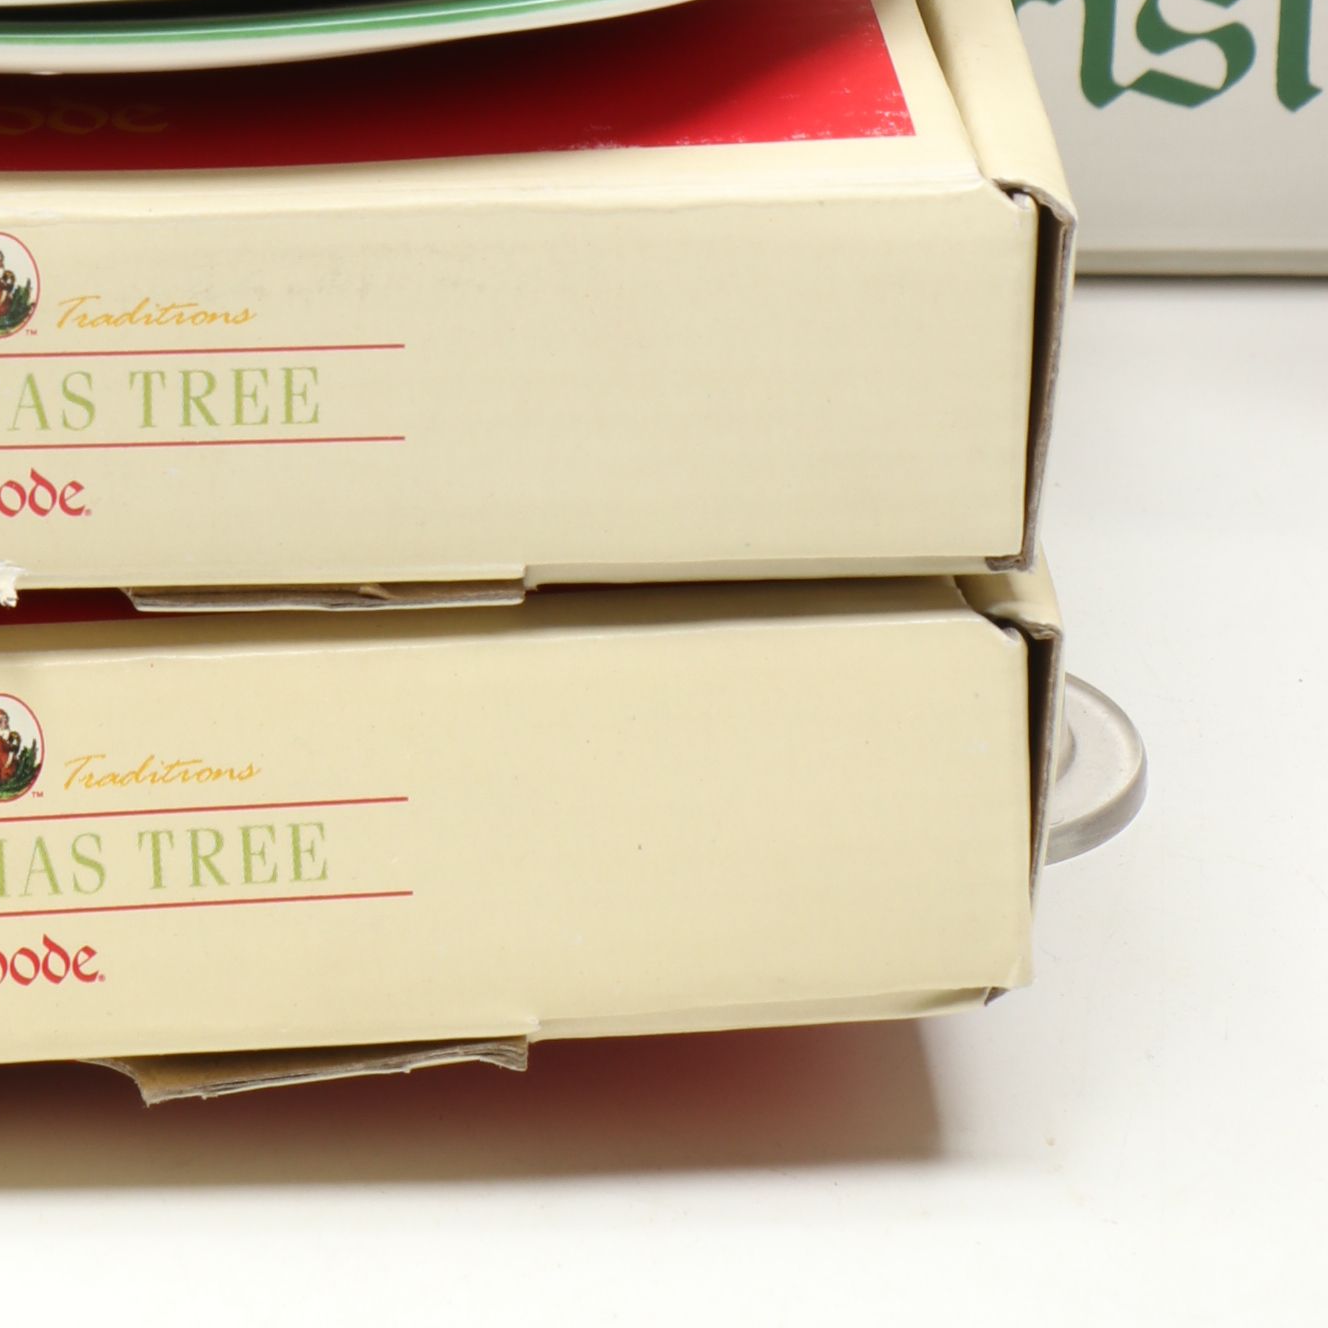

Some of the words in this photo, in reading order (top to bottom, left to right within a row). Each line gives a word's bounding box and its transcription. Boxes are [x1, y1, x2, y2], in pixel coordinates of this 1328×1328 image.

[55, 295, 257, 330] Traditions
[129, 365, 321, 429] TREE
[63, 753, 262, 791] Traditions
[138, 820, 330, 891] TREE
